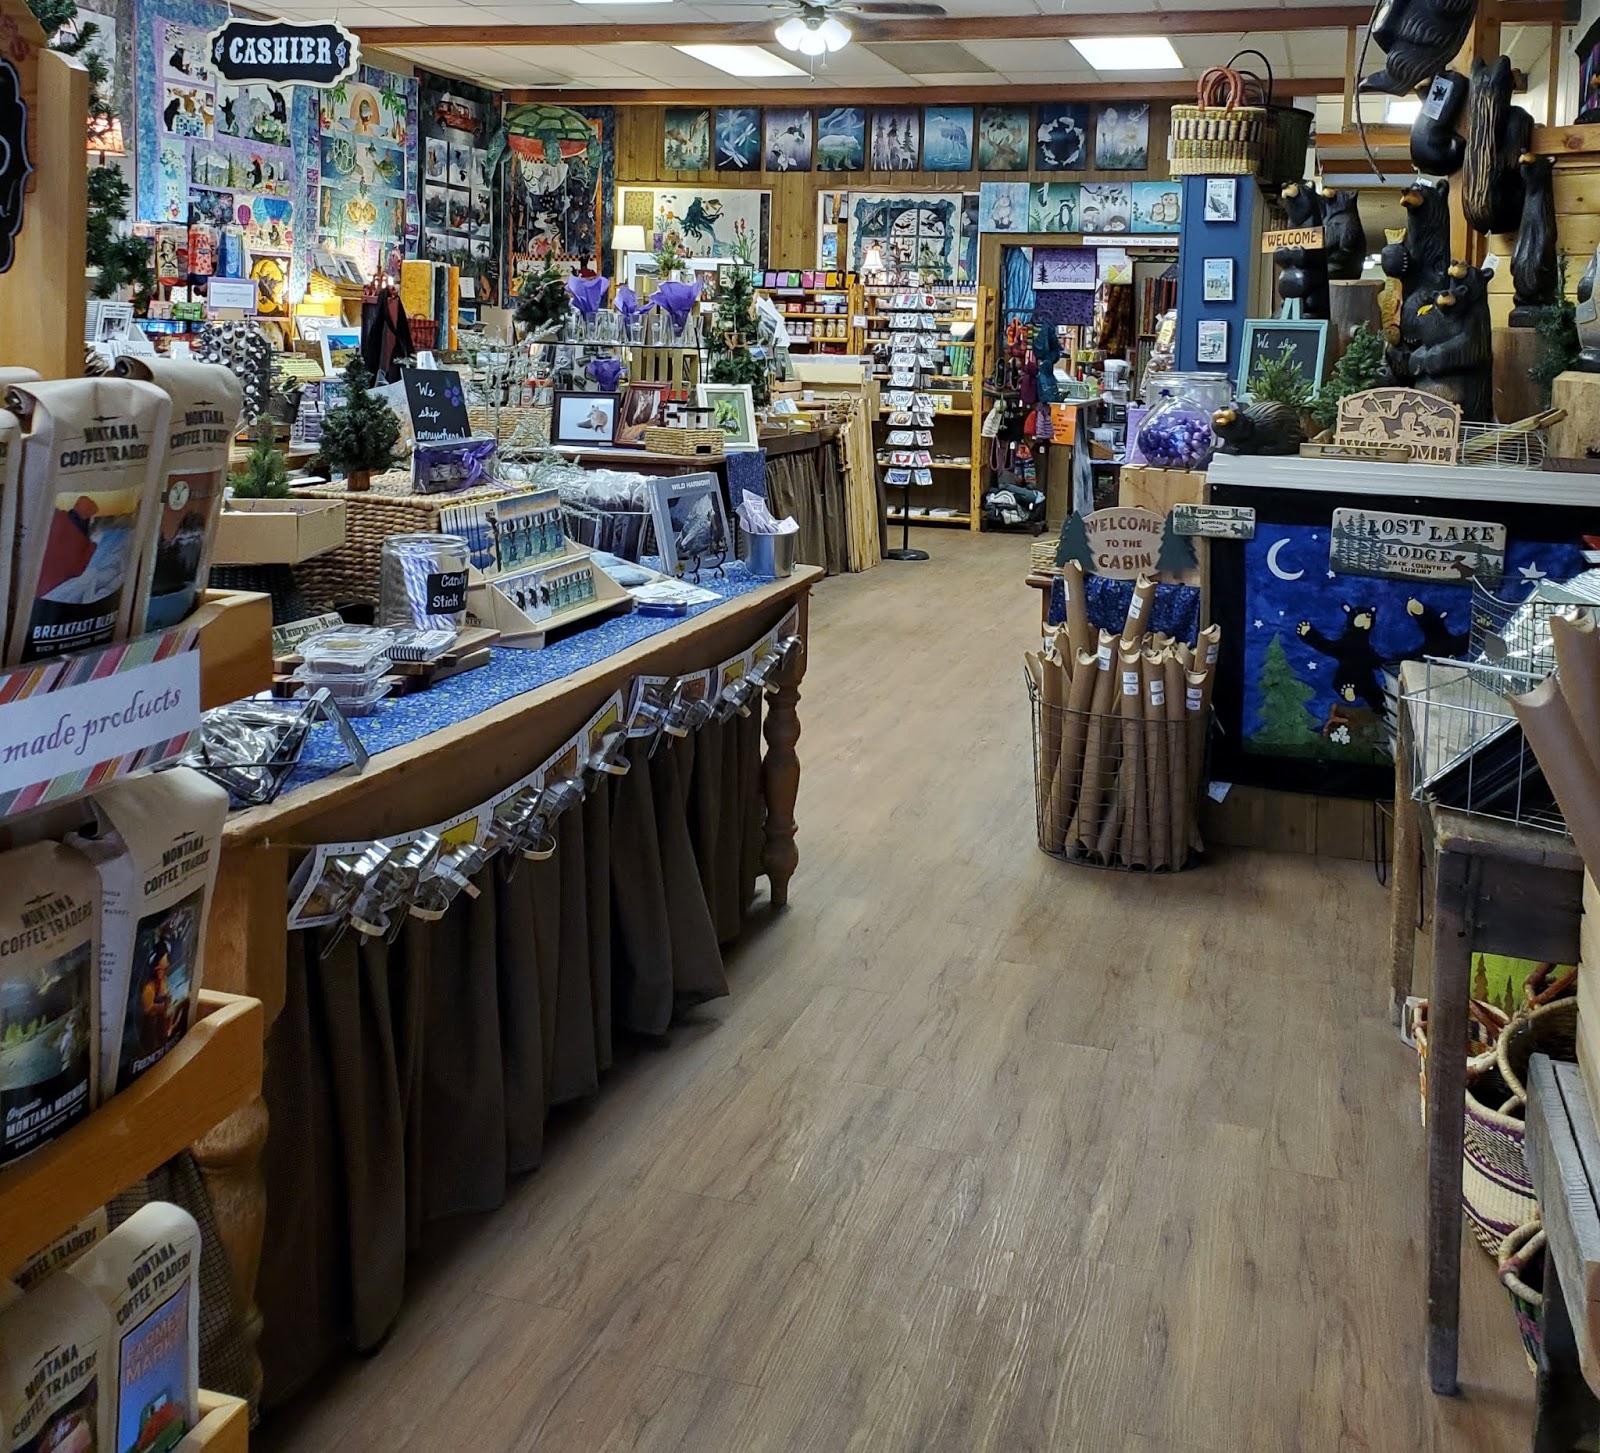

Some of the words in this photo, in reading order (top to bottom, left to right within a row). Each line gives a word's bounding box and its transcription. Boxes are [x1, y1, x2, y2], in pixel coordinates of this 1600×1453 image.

[229, 37, 332, 64] CASHIER
[1267, 231, 1317, 247] WELCOME
[1053, 275, 1086, 283] Montana
[1256, 333, 1270, 348] We
[415, 382, 435, 397] We
[418, 407, 441, 423] ship
[170, 430, 201, 448] COFFEE
[60, 448, 106, 468] COFFEE
[1320, 447, 1388, 457] LAKE
[671, 483, 686, 491] WILD
[686, 479, 711, 489] HARMONY
[1085, 516, 1162, 535] WELCOME
[1367, 519, 1425, 536] LOST
[1428, 526, 1495, 543] LAKE
[1106, 539, 1120, 548] TO
[1123, 539, 1142, 548] THE
[1386, 545, 1452, 562] LODGE
[1098, 552, 1152, 570] CABIN
[1401, 567, 1432, 575] LUXURY
[1411, 562, 1448, 572] COUNTRY
[441, 574, 467, 589] Candy
[33, 618, 95, 639] BREAKFAST
[95, 611, 118, 629] BLE
[3, 713, 76, 764] made
[75, 688, 182, 756] products
[162, 835, 204, 868] MONTANA
[144, 864, 179, 896] COFFEE
[21, 894, 76, 929] MONTANA
[1, 925, 48, 957] COFFEE
[132, 1048, 165, 1074] FRENCH
[6, 1104, 53, 1138] MONTANA
[51, 1227, 97, 1265] TRADERS
[127, 1243, 176, 1291] MONTANA
[116, 1283, 151, 1326] COFFEE
[152, 1250, 191, 1292] TRADERS
[25, 1344, 79, 1400] MONTANA
[12, 1389, 46, 1439] COFFEE
